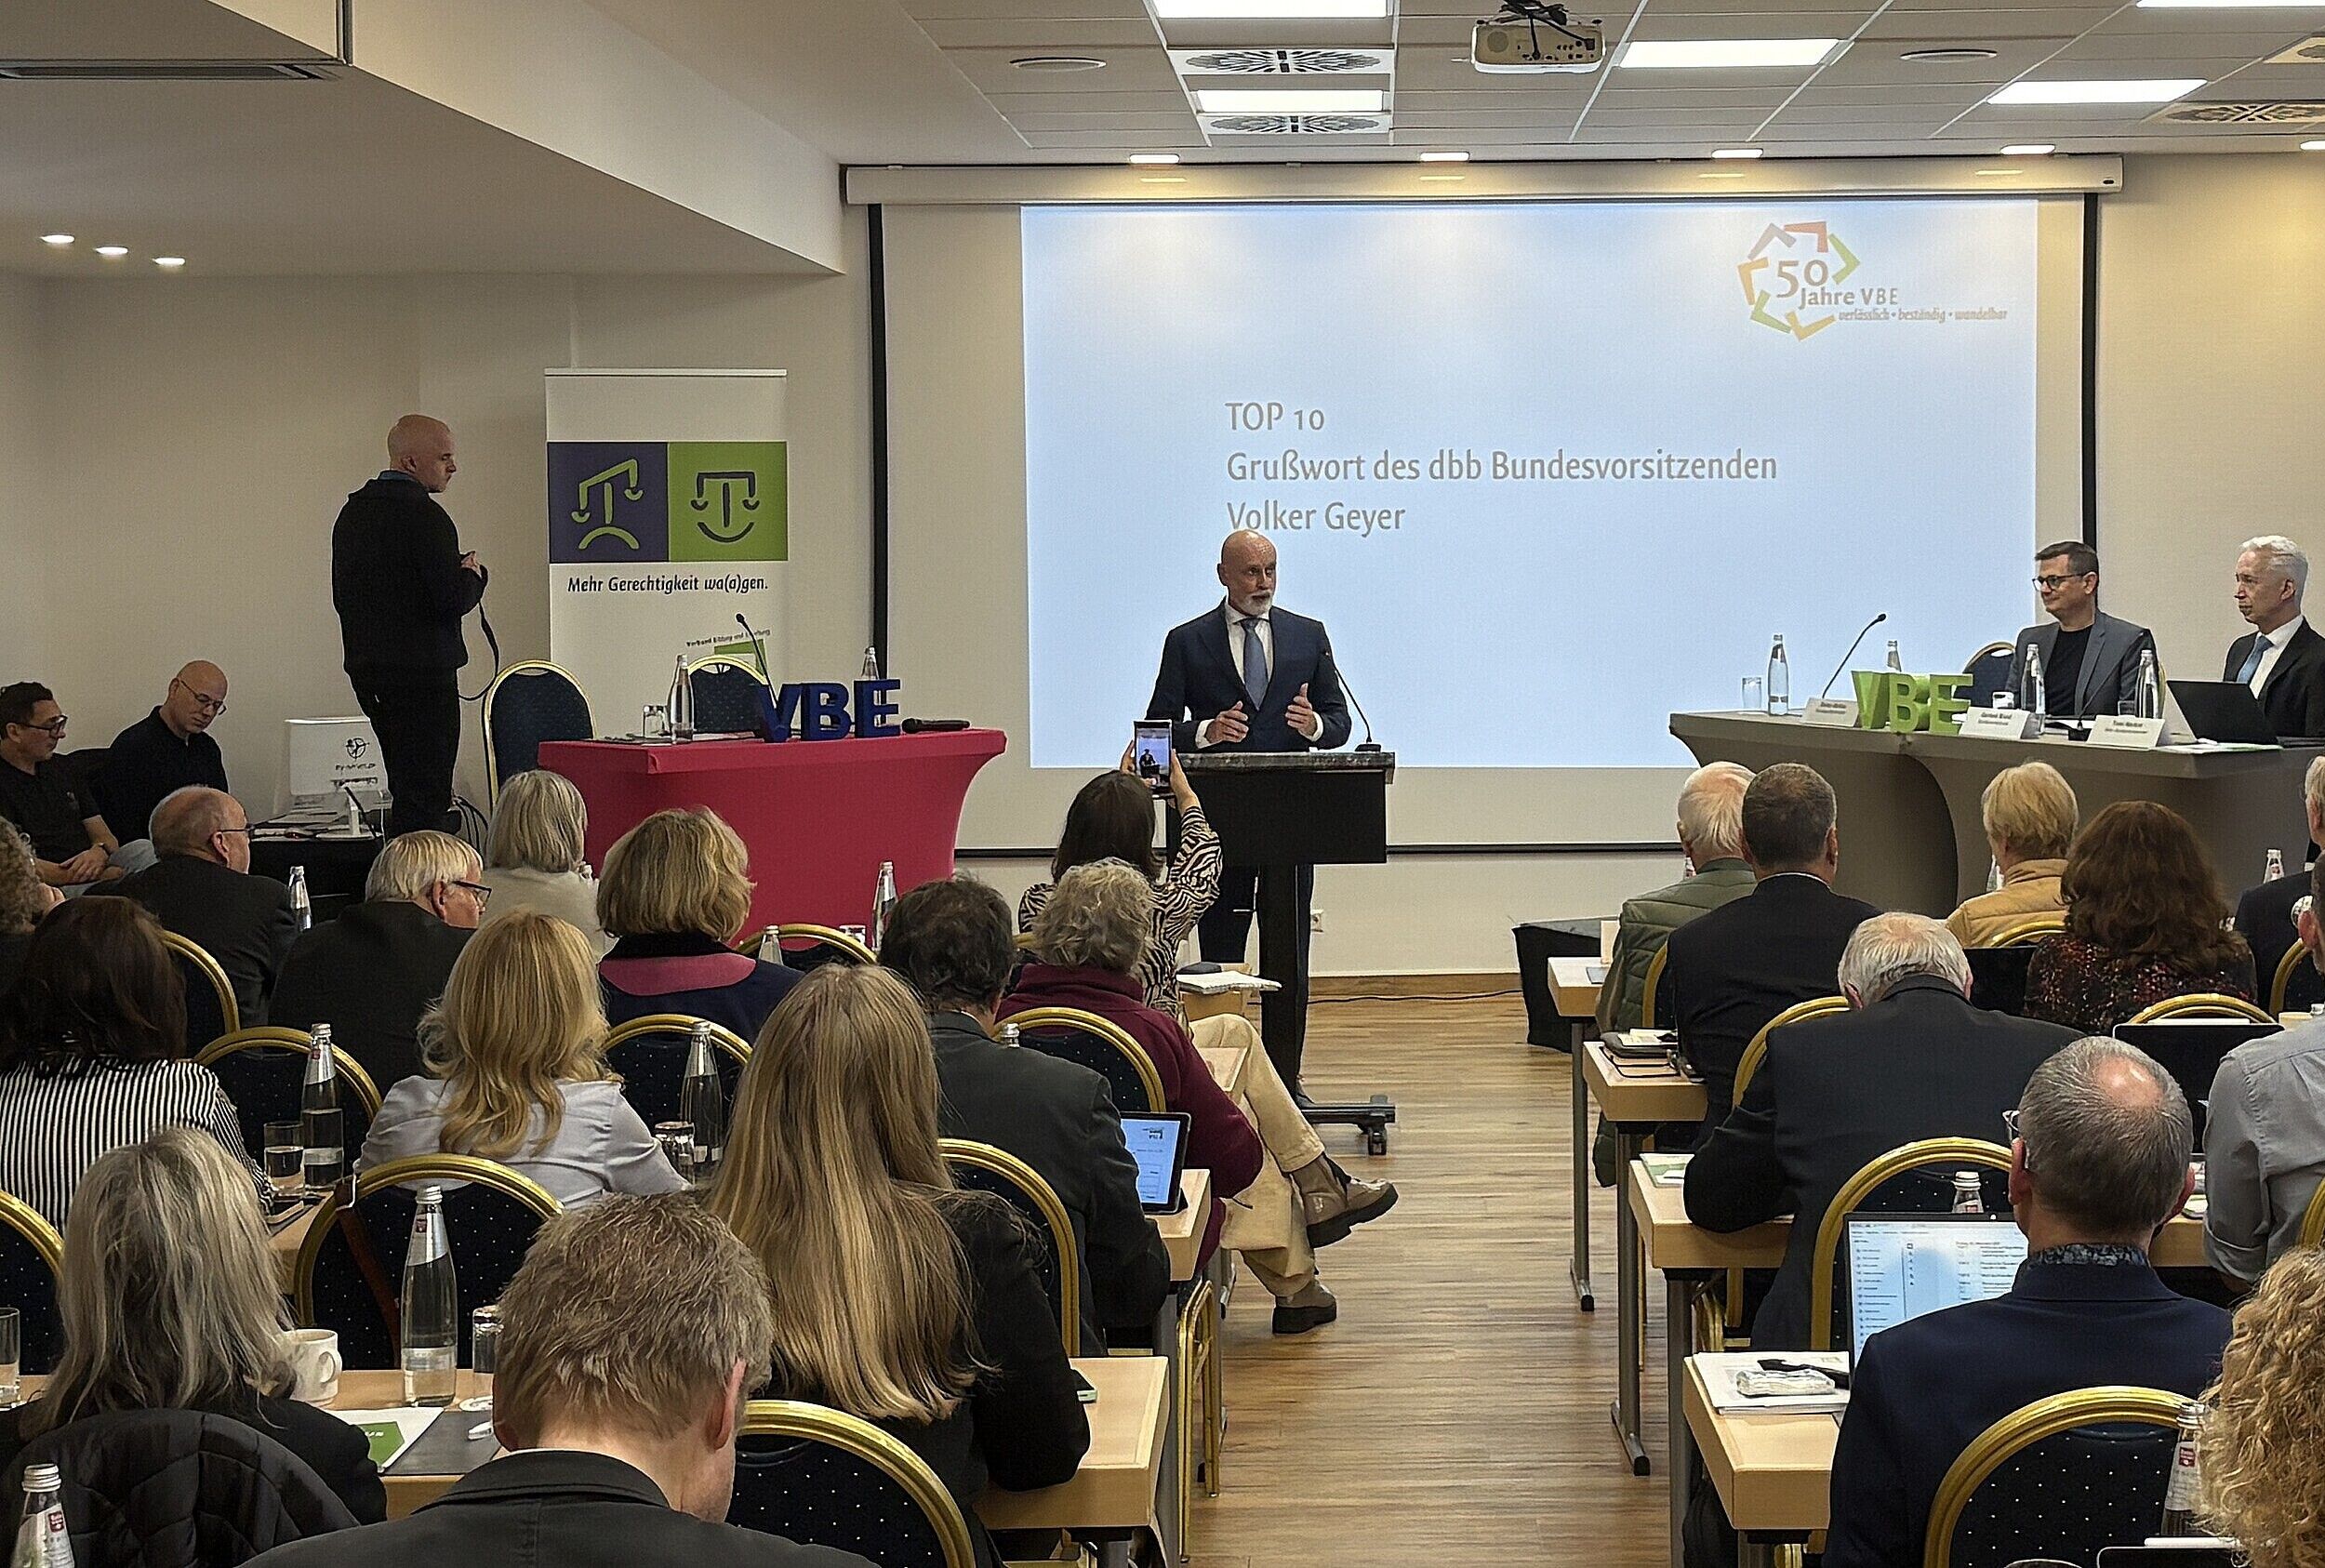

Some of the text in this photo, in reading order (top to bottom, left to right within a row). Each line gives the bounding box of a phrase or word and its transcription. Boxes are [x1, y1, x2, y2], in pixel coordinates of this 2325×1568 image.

[1776, 259, 1828, 299] 50
[1798, 286, 1898, 310] Jahre VBE
[1224, 402, 1325, 431] TOP 10
[1227, 448, 1777, 481] Grußwort des dbb Bundesvorsitzenden
[1227, 499, 1406, 538] Volker Geyer
[567, 573, 768, 595] Mehr Gerechtigkeit wa(a)gen.
[757, 679, 901, 743] VBE
[1852, 671, 1973, 737] VBE
